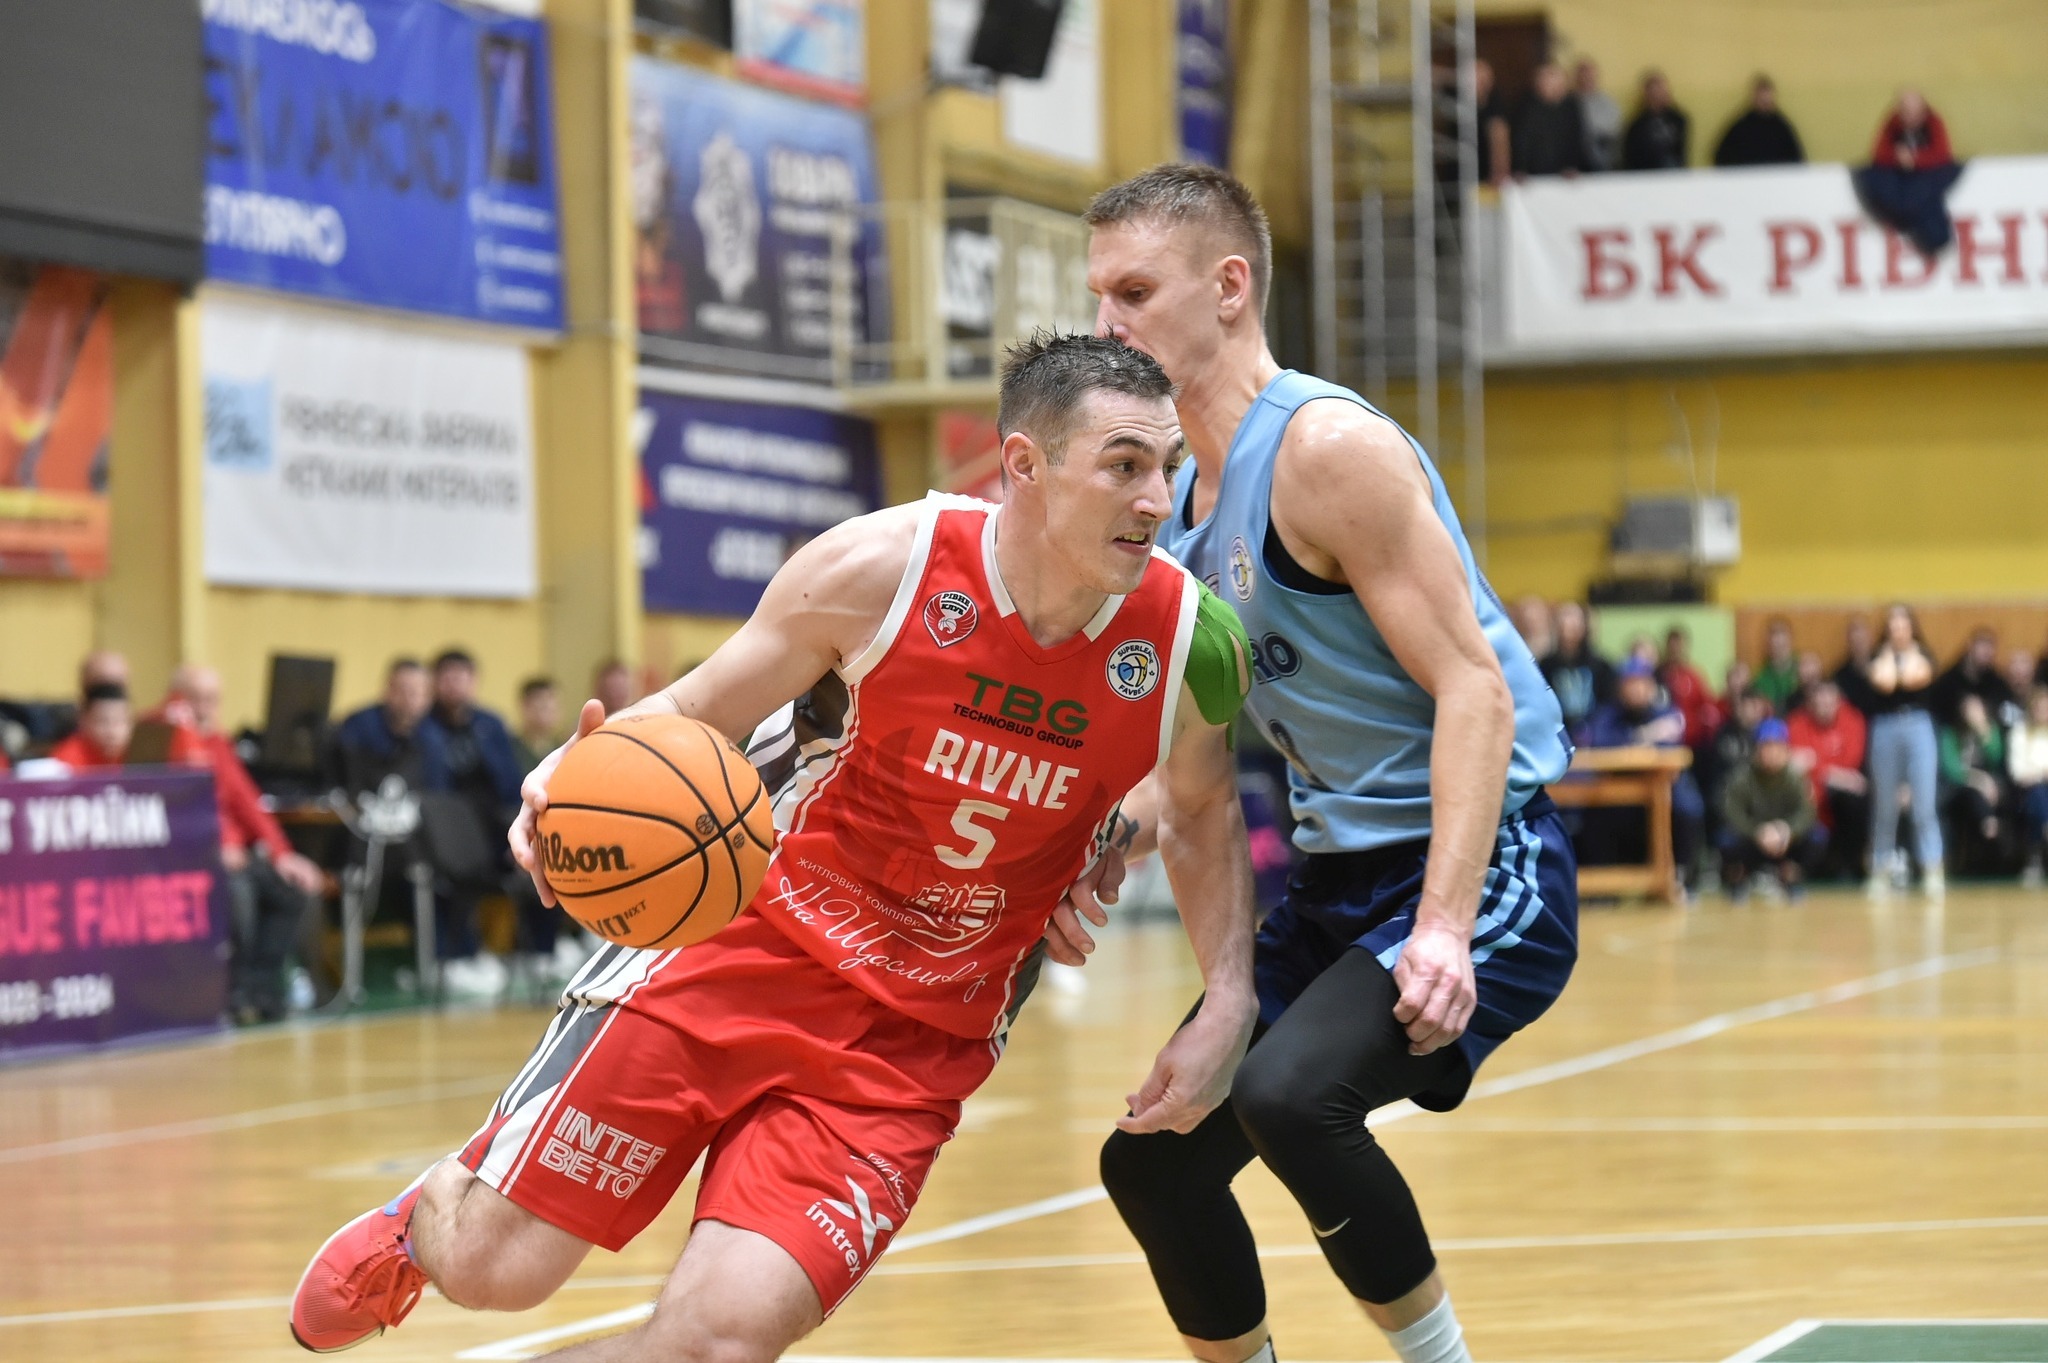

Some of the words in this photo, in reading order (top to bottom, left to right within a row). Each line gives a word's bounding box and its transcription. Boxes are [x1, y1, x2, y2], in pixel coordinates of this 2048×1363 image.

[1580, 221, 1724, 301] БК
[1764, 209, 2048, 294] РІВН
[942, 593, 970, 607] РІВНЕ
[965, 671, 1090, 736] TBG
[1118, 685, 1145, 696] FAVBET
[952, 703, 1034, 738] TECHNOBUD
[1036, 730, 1084, 750] GROUP
[923, 728, 1080, 810] RIVNE
[933, 799, 1011, 869] 5
[74, 869, 213, 949] FAVBET
[767, 876, 831, 926] На
[552, 1105, 667, 1176] INTER
[805, 1202, 860, 1279] imtrex
